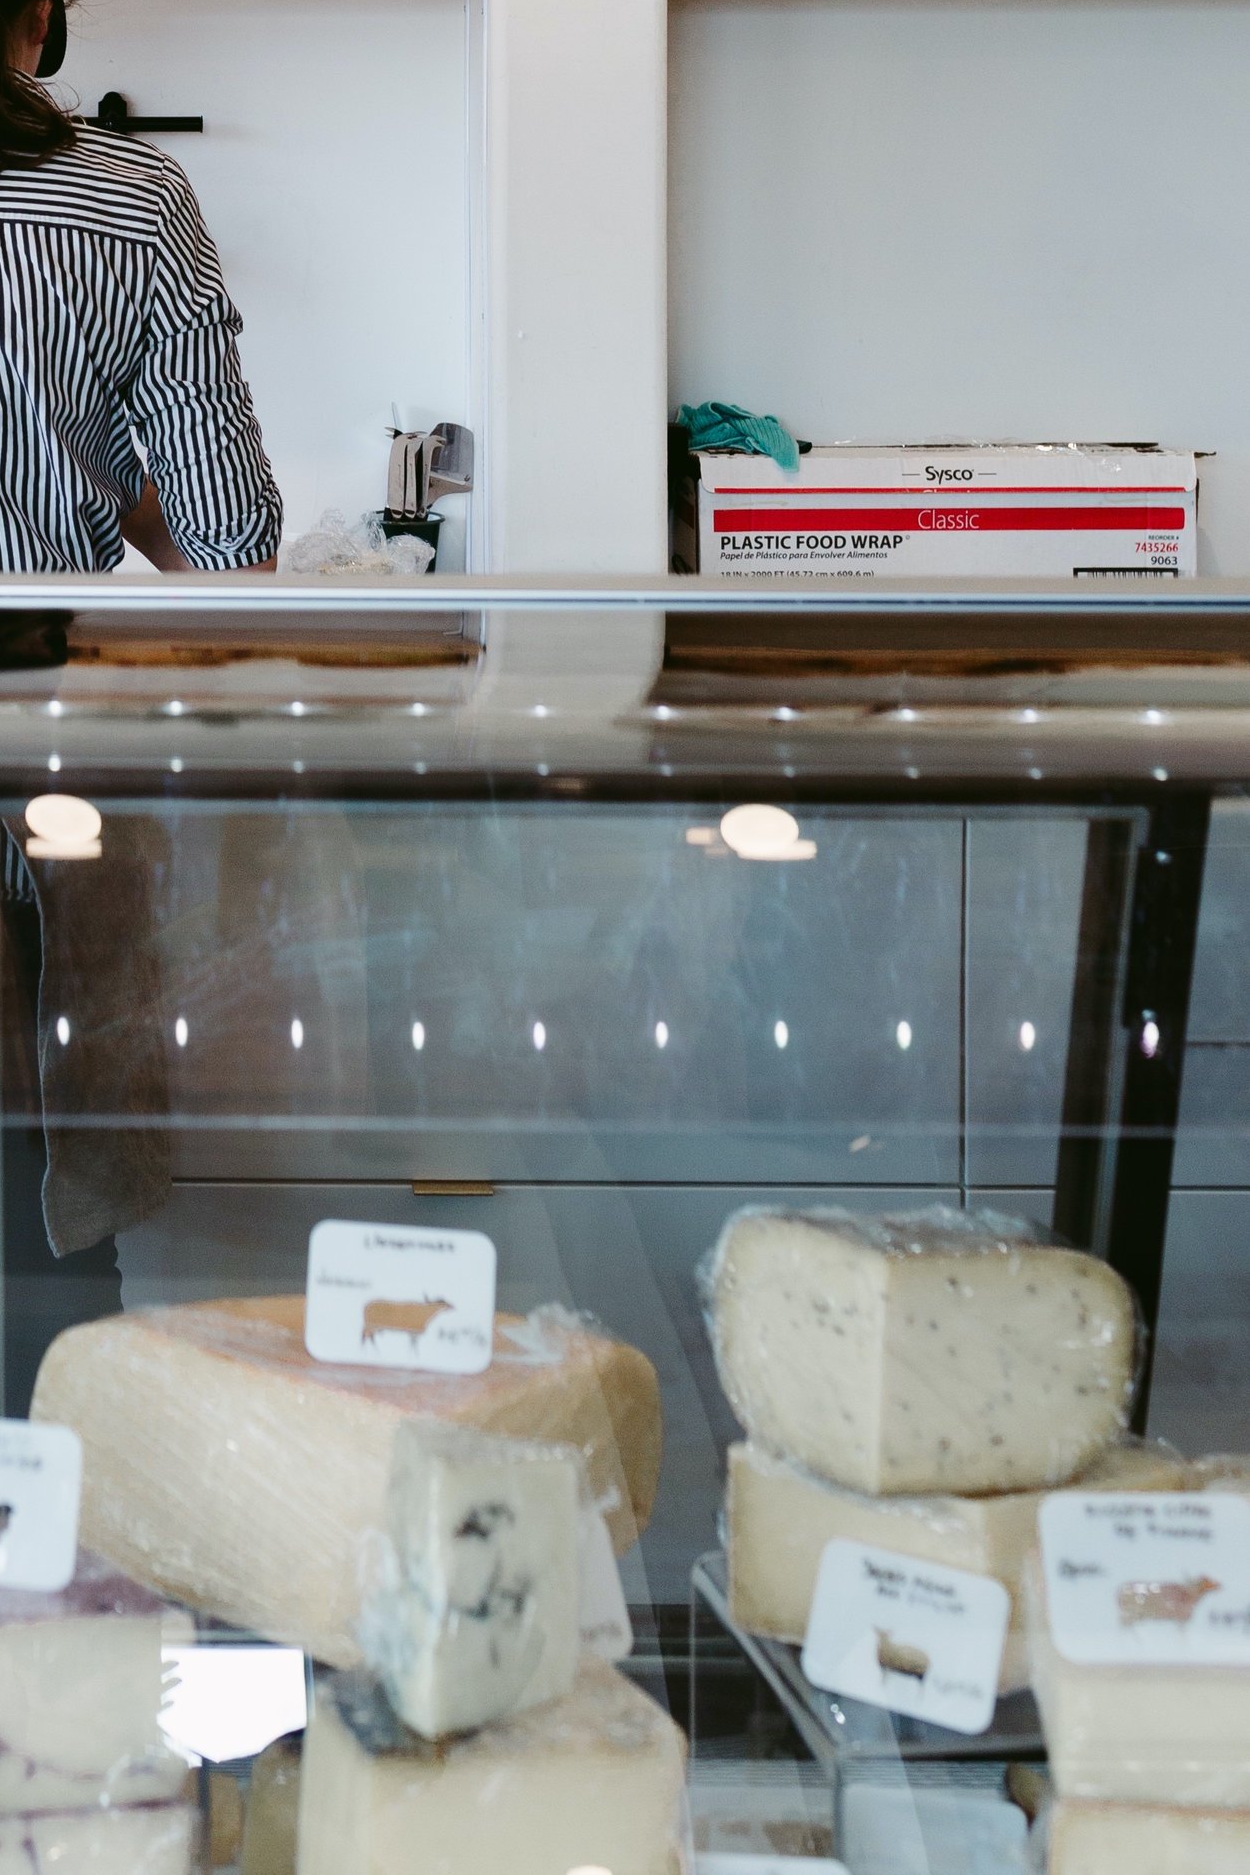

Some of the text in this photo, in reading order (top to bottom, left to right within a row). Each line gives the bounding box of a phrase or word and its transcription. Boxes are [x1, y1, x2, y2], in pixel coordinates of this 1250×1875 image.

[925, 466, 973, 485] Sysco
[917, 509, 980, 530] Classic
[720, 535, 903, 550] PLASTIC FOOD WRAP
[1135, 542, 1179, 553] 7435266
[720, 551, 888, 561] Papel de Plástico para Envolver Alimentos
[1150, 556, 1178, 566] 9063
